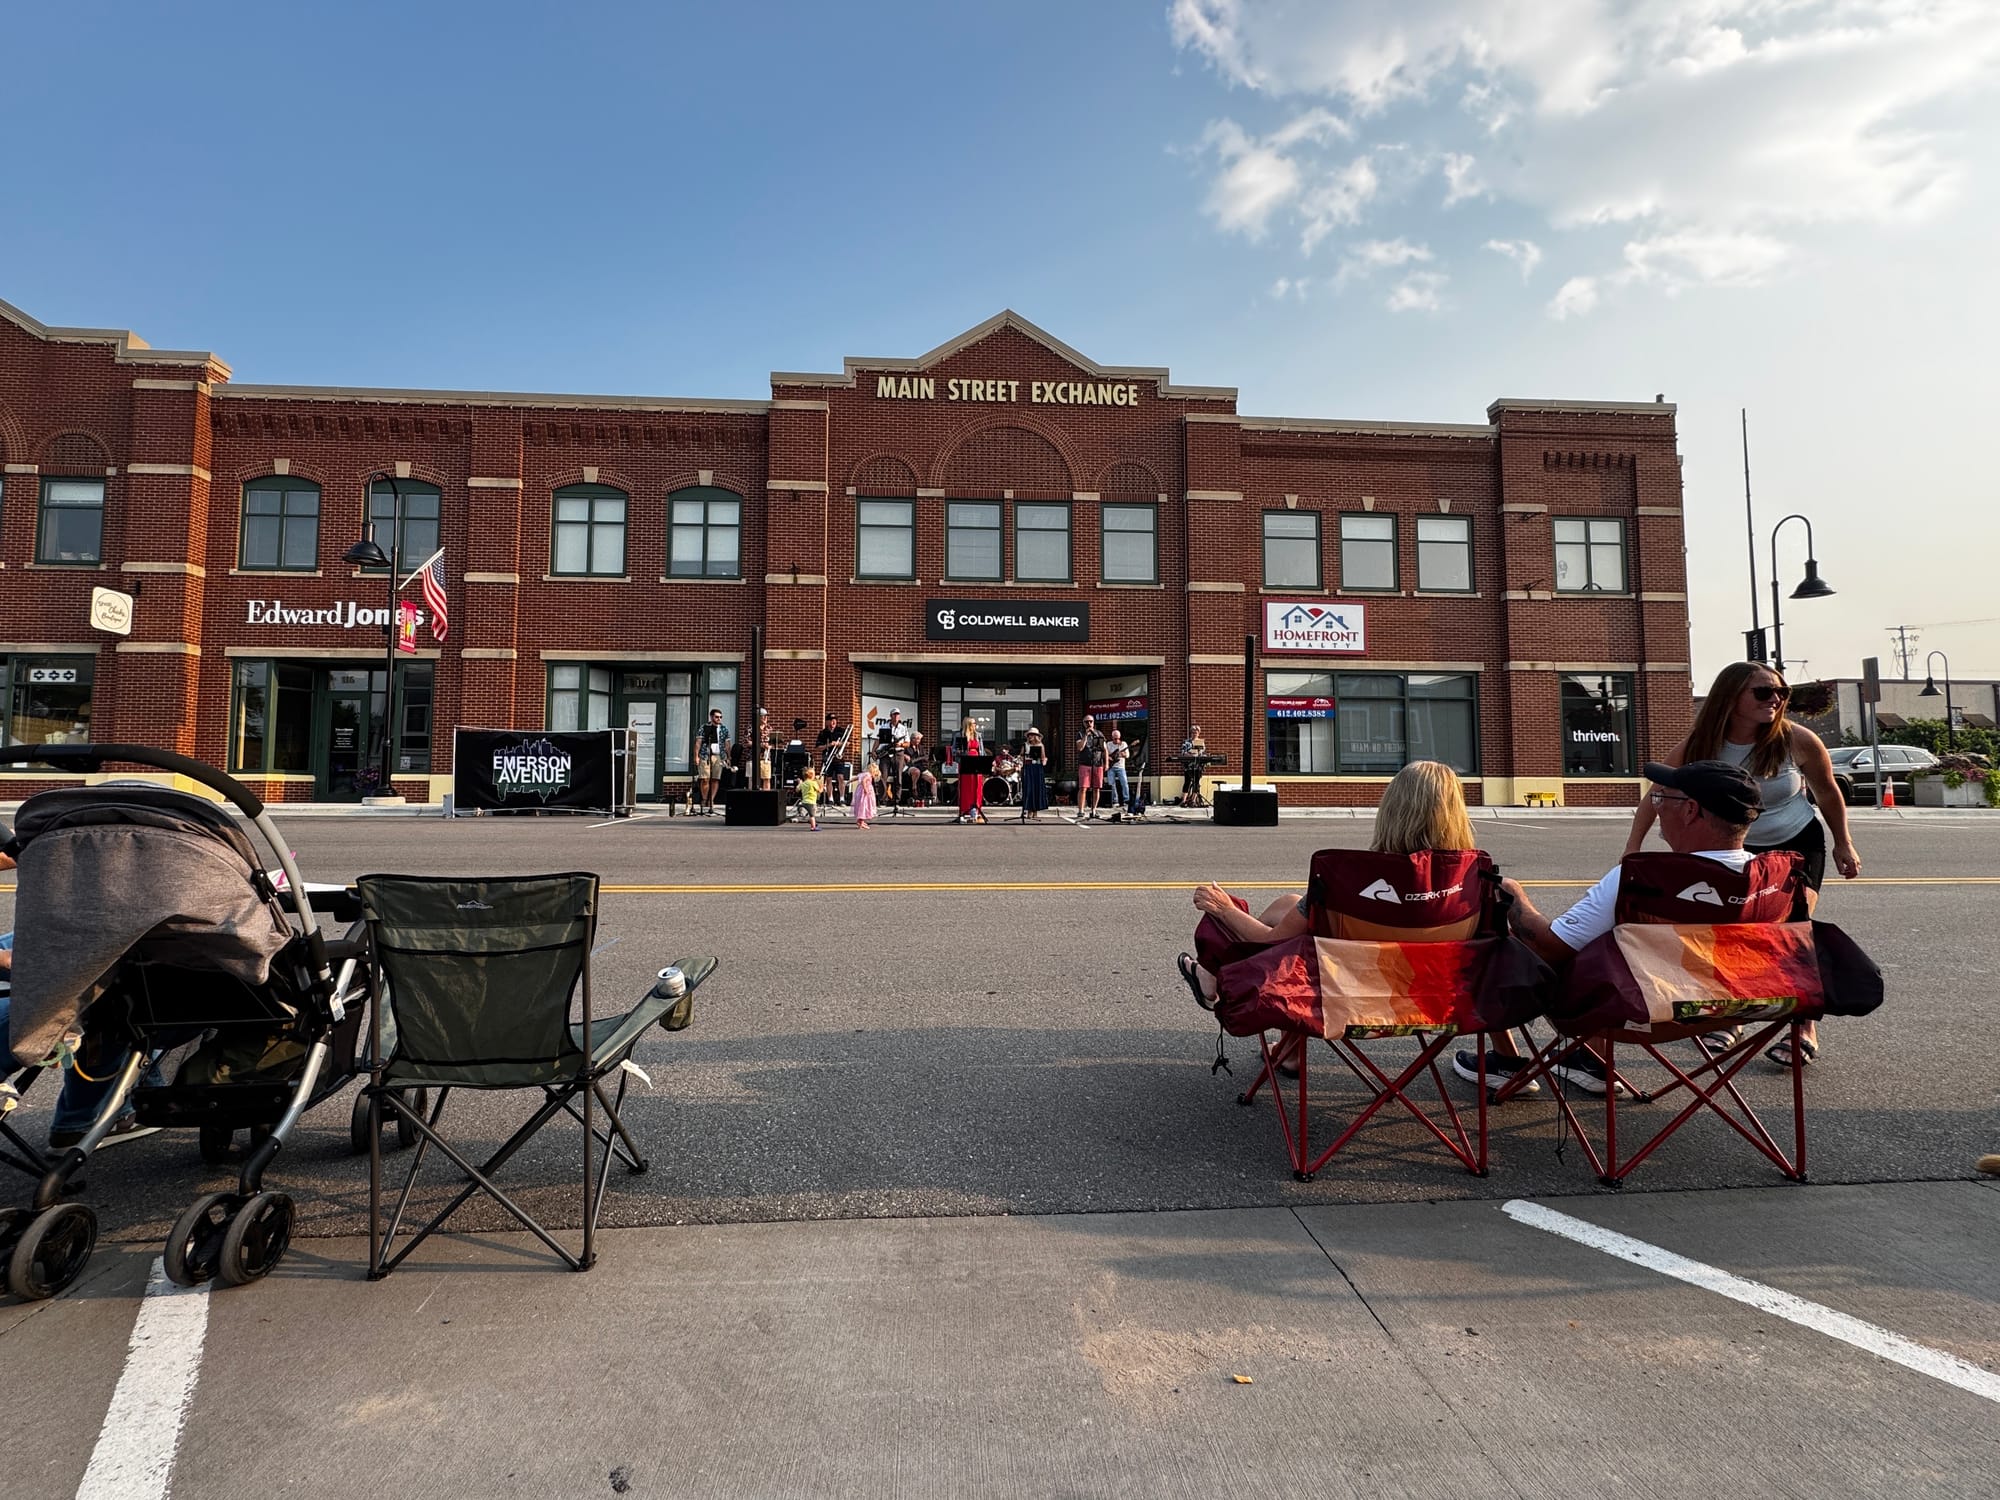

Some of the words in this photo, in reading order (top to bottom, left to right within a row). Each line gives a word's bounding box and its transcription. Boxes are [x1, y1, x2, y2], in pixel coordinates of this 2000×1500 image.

[877, 376, 935, 400] MAIN
[948, 378, 1020, 402] STREET
[1031, 381, 1138, 406] EXCHANGE
[245, 600, 343, 624] Edward
[959, 615, 1026, 626] COLDWELL
[1029, 616, 1080, 627] BANKER
[1273, 630, 1359, 642] HOMEFRONT
[493, 755, 571, 770] EMERSON
[498, 768, 566, 784] AVENUE
